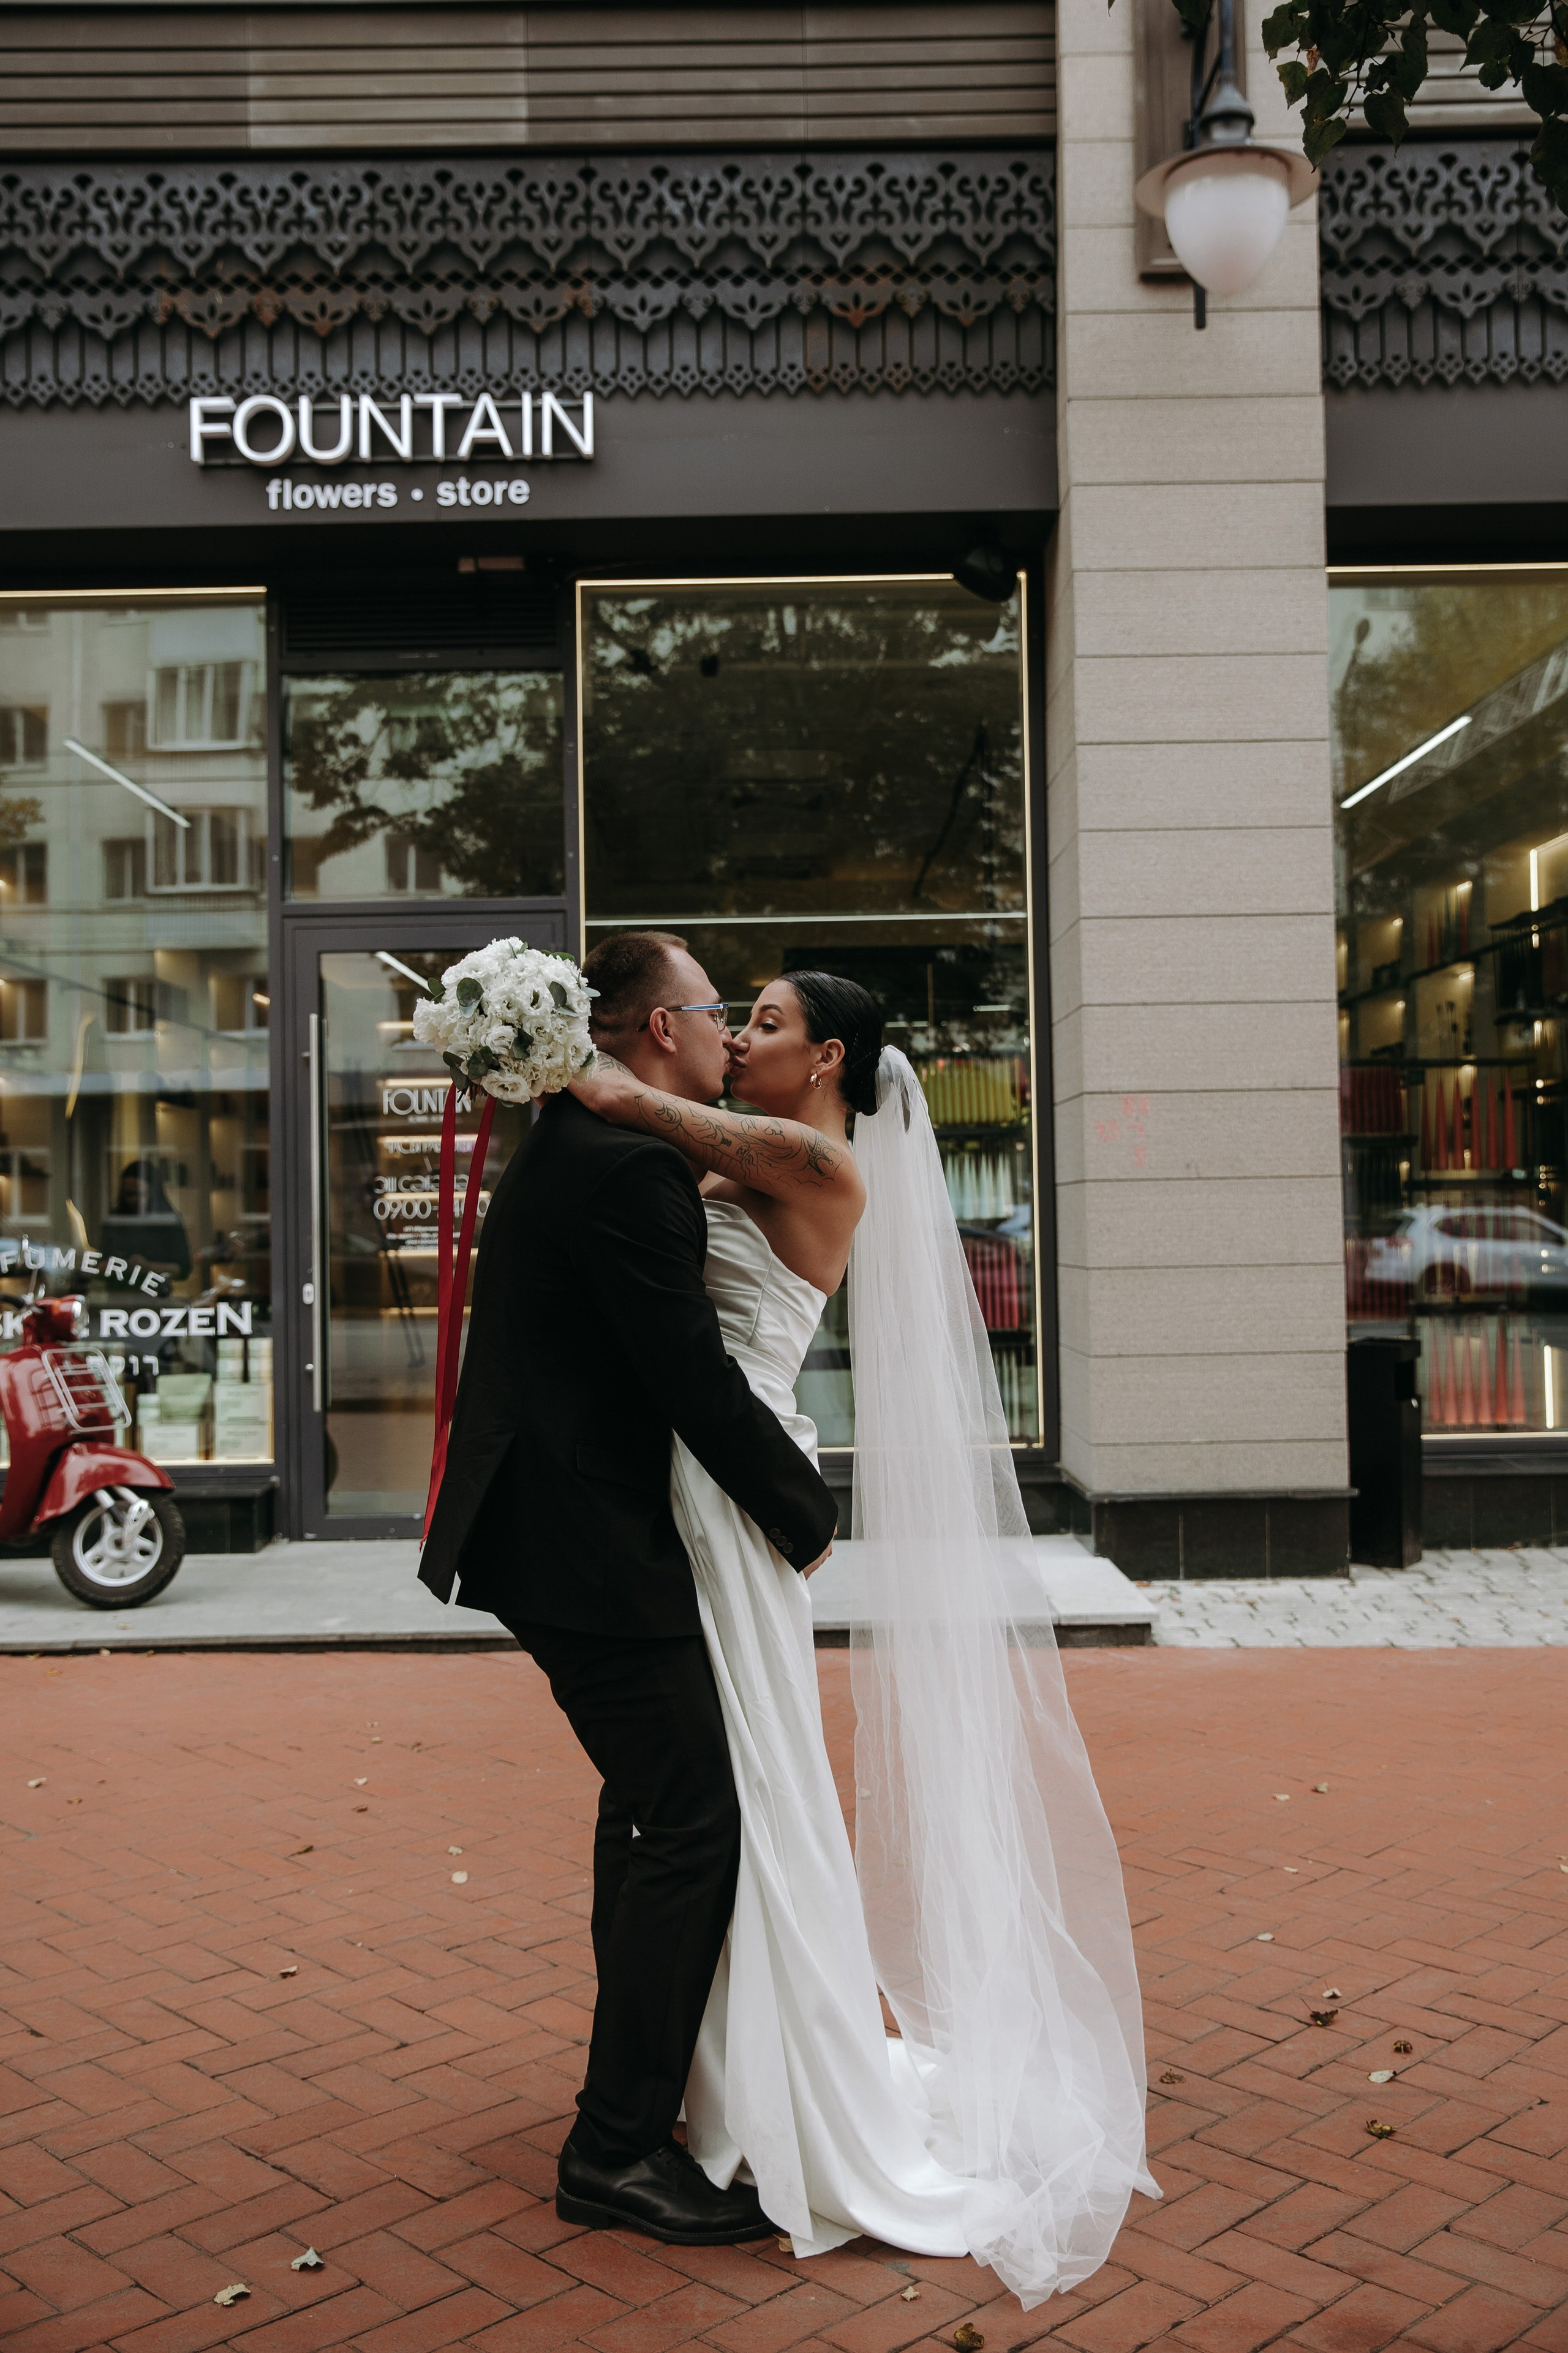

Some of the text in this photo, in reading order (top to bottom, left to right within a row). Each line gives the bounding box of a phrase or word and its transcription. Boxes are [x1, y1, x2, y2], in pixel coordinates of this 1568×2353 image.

[189, 391, 594, 464] FOUNTAIN
[266, 477, 531, 510] flowers store
[0, 1247, 166, 1297] FUMERIE
[99, 1301, 252, 1338] ROZEN
